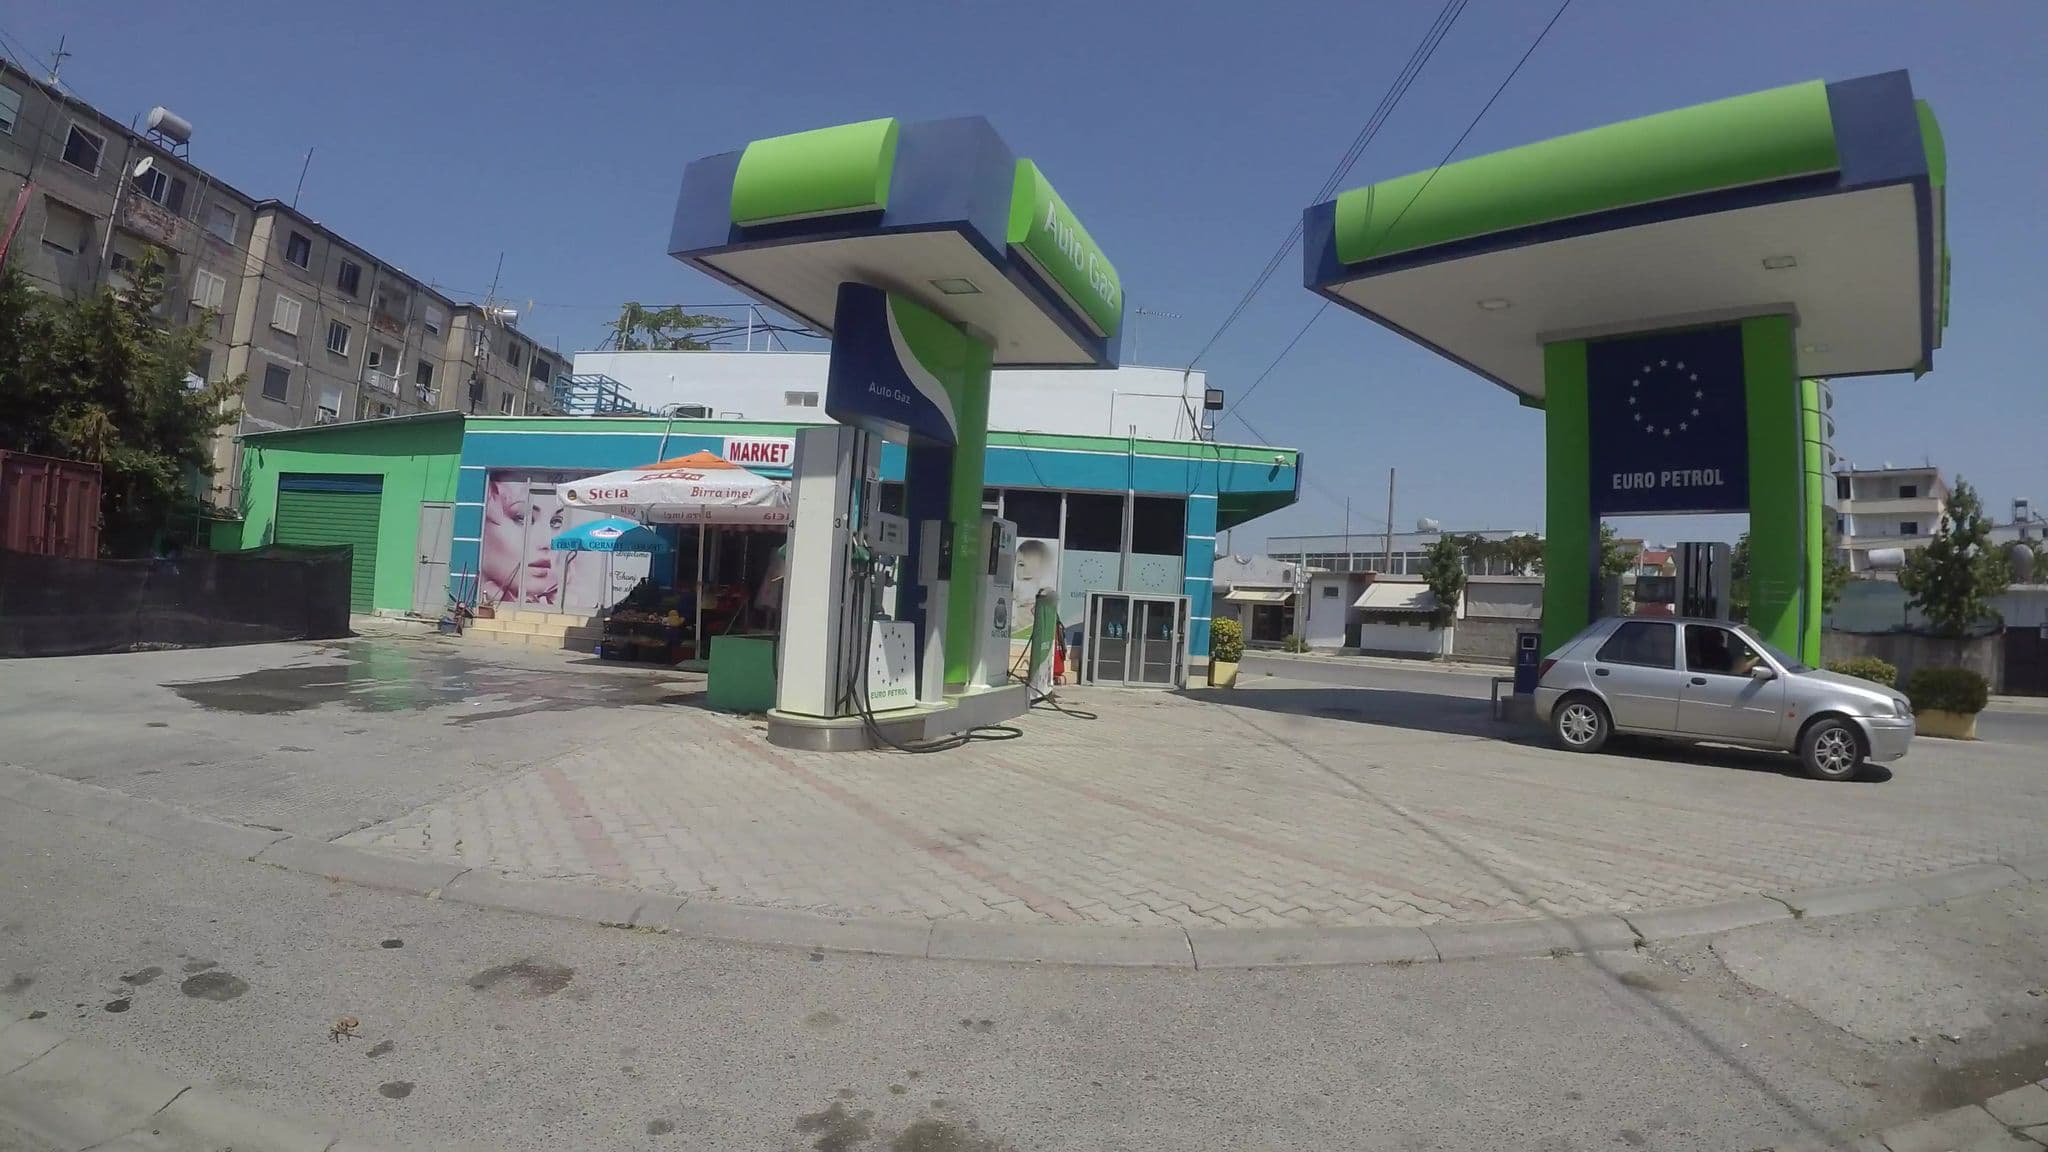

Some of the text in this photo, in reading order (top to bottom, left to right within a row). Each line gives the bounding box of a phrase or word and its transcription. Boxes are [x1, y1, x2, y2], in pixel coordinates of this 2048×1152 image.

[1044, 200, 1115, 309] Auto Gaz
[869, 381, 911, 404] Auto Gaz
[729, 442, 790, 463] MARKET
[1612, 468, 1725, 490] EURO PETROL
[588, 486, 754, 500] Stela Birra ime!
[788, 519, 796, 530] 4
[834, 518, 842, 529] 3
[870, 687, 908, 699] EURO PETROL
